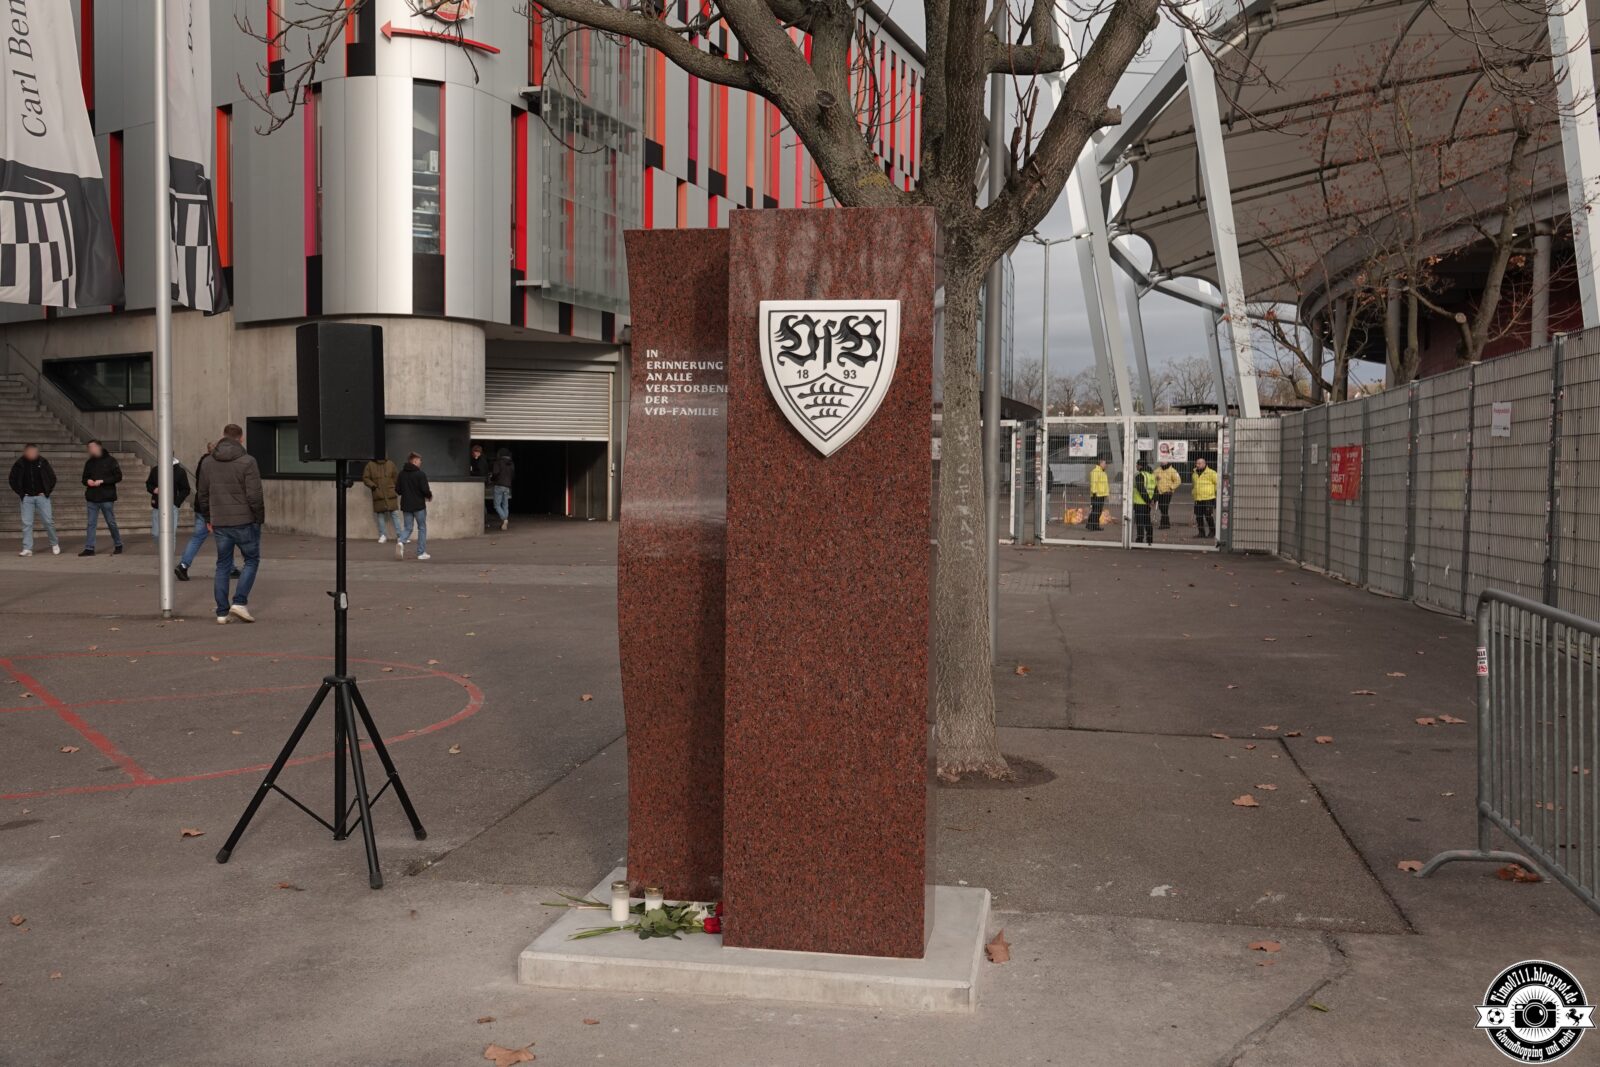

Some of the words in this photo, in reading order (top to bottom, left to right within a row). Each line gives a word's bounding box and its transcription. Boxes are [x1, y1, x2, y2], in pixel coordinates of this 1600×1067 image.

[12, 69, 47, 137] Carl
[774, 314, 882, 370] VfB
[646, 349, 658, 358] IN
[646, 361, 724, 370] ERINNERUNG
[646, 373, 662, 382] AN
[665, 373, 693, 382] ALLE
[796, 370, 809, 380] 18
[843, 370, 857, 380] 93
[645, 395, 669, 404] DER
[644, 407, 719, 416] VfB-FAMILIE
